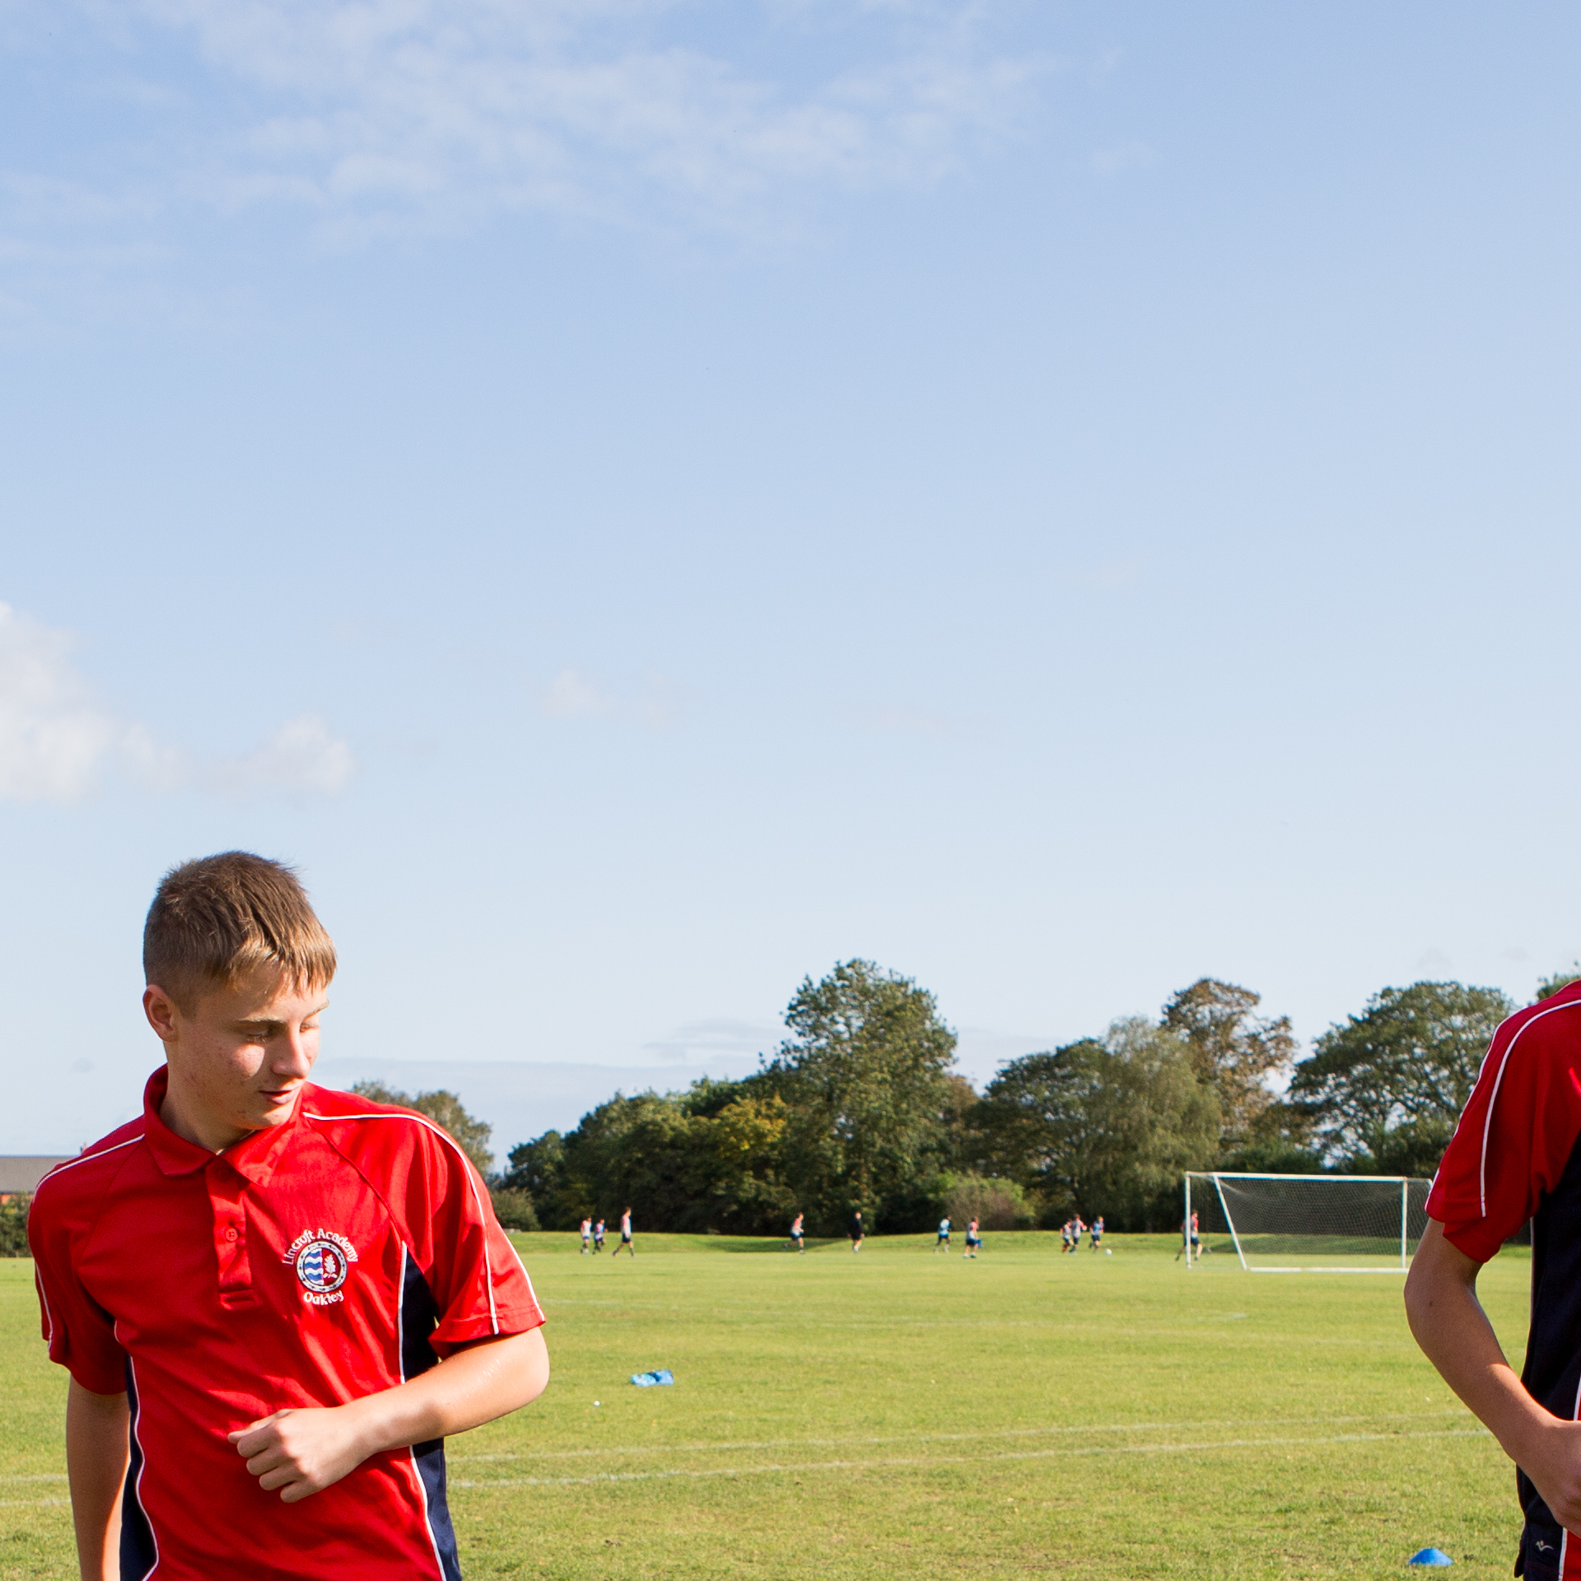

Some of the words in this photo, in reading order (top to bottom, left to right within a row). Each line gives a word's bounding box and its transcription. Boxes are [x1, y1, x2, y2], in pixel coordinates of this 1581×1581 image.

[282, 1229, 316, 1265] Lincroft
[317, 1228, 359, 1262] Academy
[303, 1290, 344, 1306] Oakley
